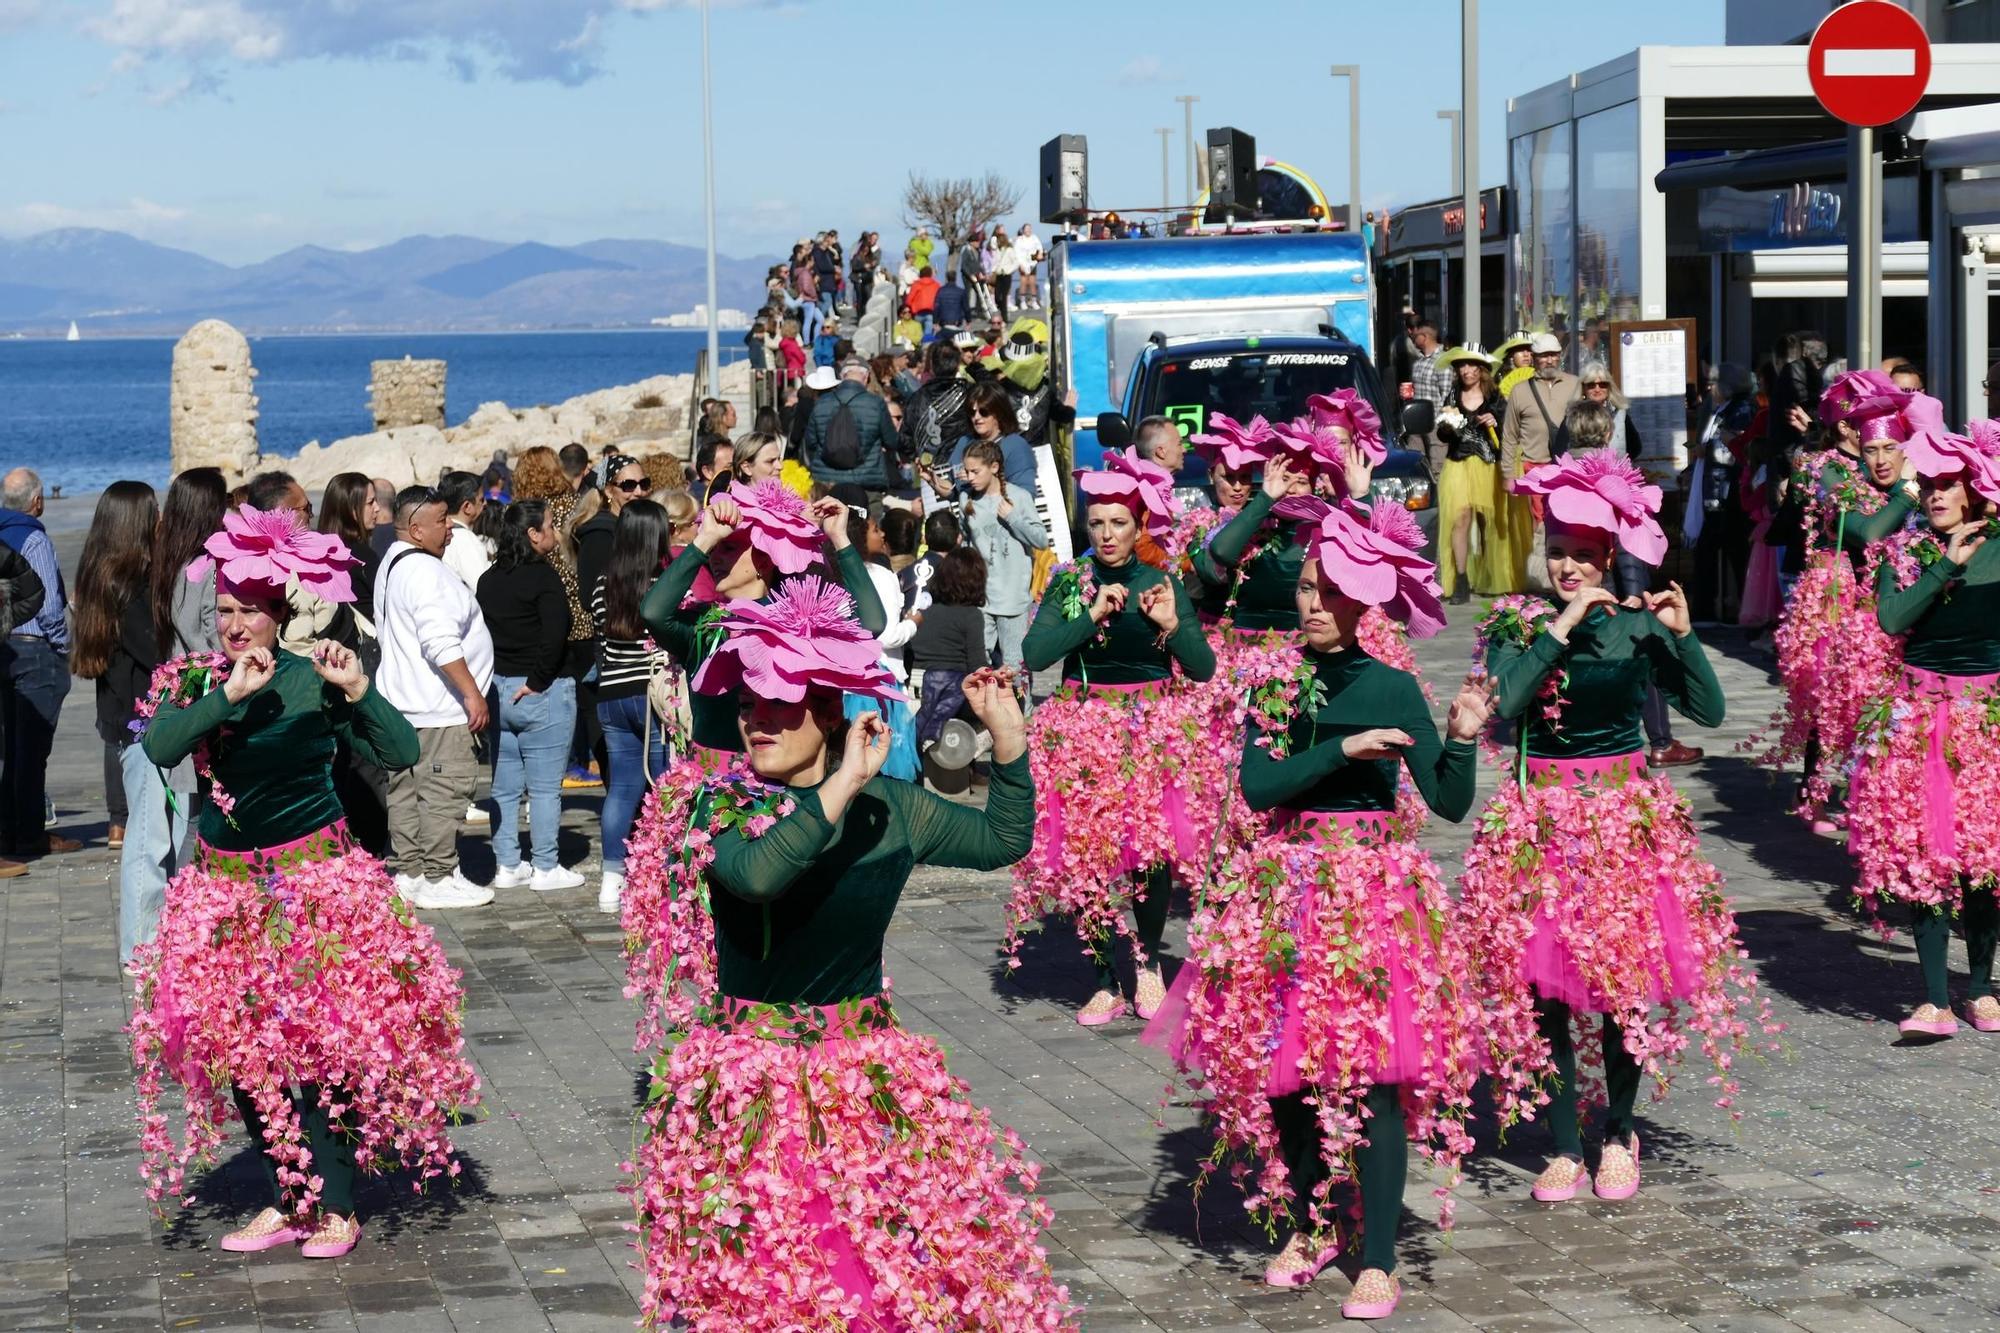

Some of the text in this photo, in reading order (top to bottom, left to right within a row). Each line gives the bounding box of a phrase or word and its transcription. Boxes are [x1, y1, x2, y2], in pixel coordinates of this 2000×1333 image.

[1643, 332, 1674, 344] CARTA
[1189, 354, 1349, 370] SENSE ENTREBANCS
[1170, 407, 1199, 443] 5
